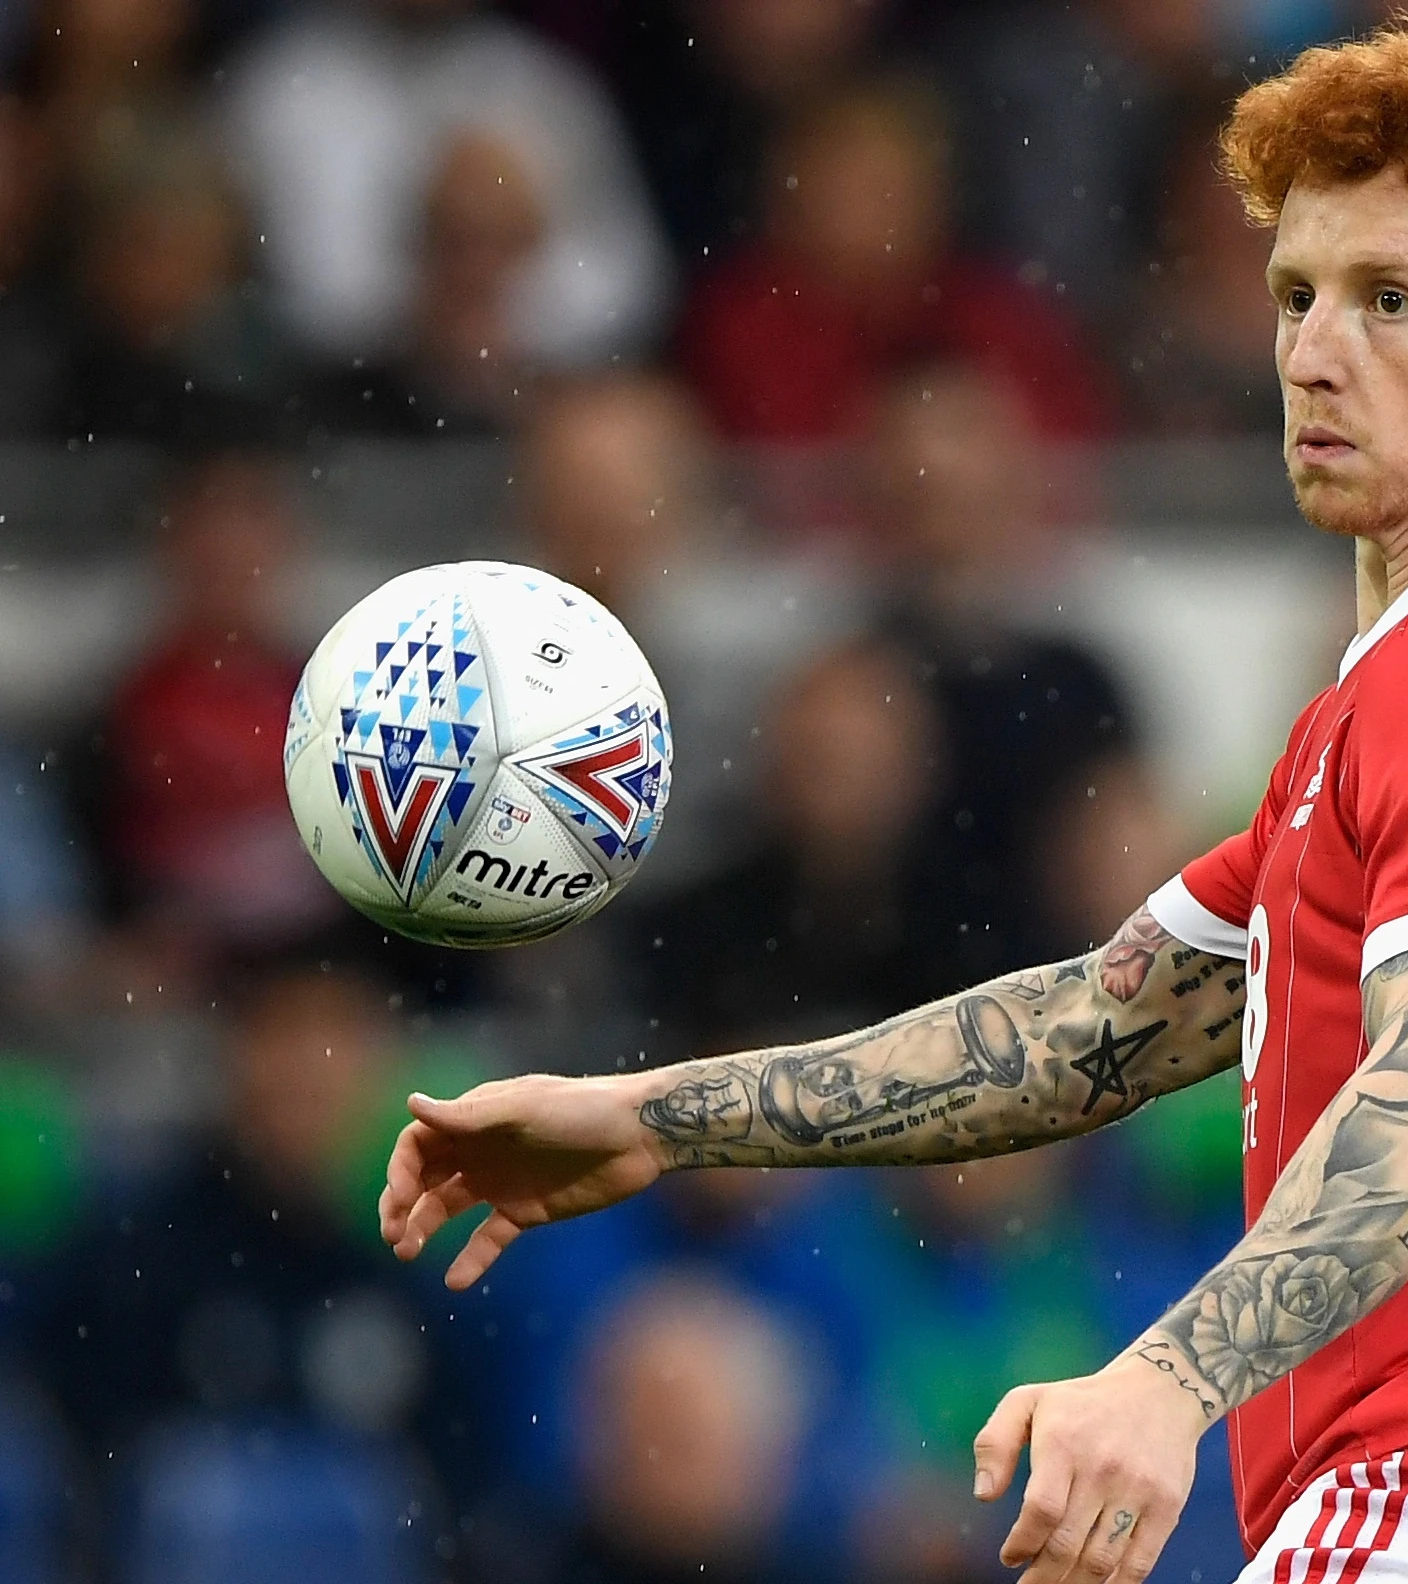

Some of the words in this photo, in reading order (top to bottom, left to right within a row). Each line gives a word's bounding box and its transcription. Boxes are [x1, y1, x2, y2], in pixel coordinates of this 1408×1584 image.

[456, 850, 593, 899] mitre
[907, 1112, 926, 1128] for
[1128, 1340, 1215, 1419] Love
